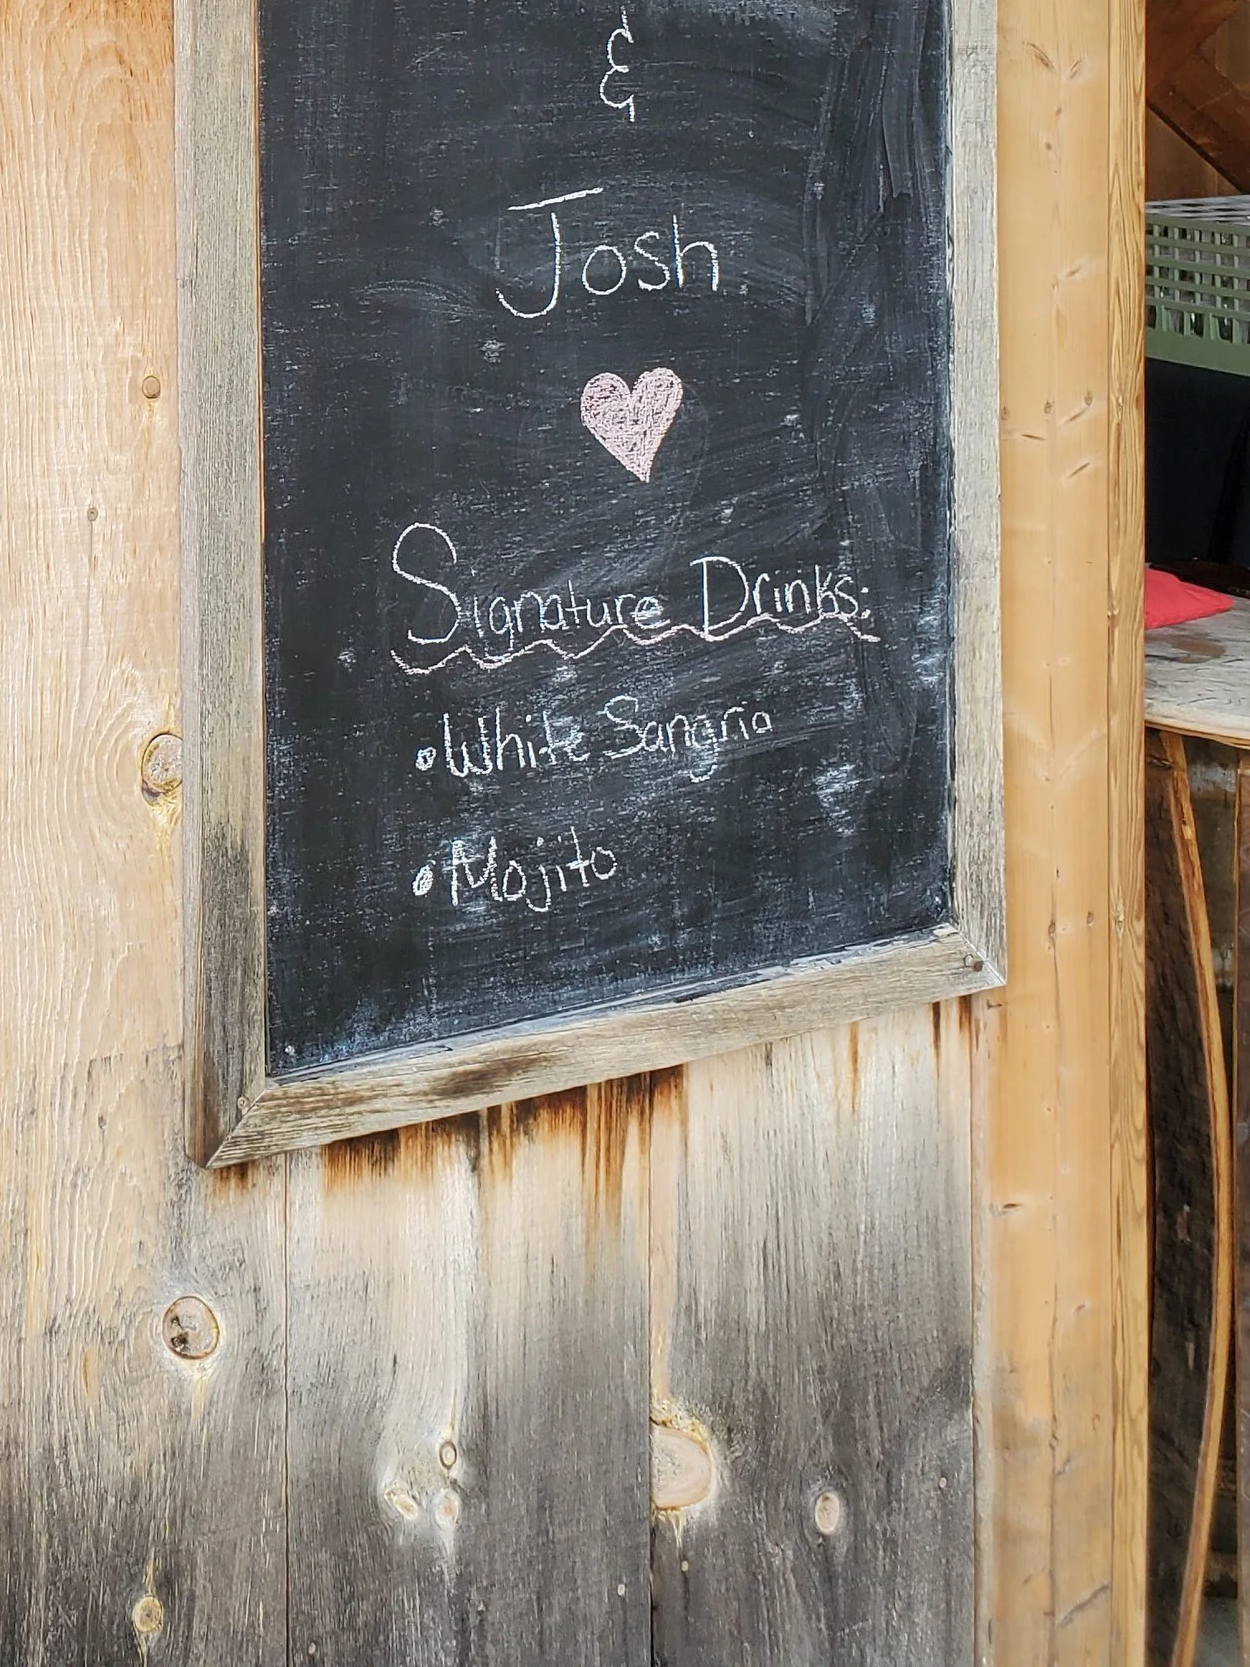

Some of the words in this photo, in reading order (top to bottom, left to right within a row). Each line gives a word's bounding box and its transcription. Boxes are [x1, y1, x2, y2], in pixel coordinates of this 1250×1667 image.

[598, 6, 636, 123] &
[495, 186, 720, 319] Josh
[391, 522, 667, 645] Signature
[689, 555, 871, 641] Drinks:
[442, 711, 590, 778] White
[601, 694, 773, 783] Sangria
[448, 827, 618, 912] Mojito
